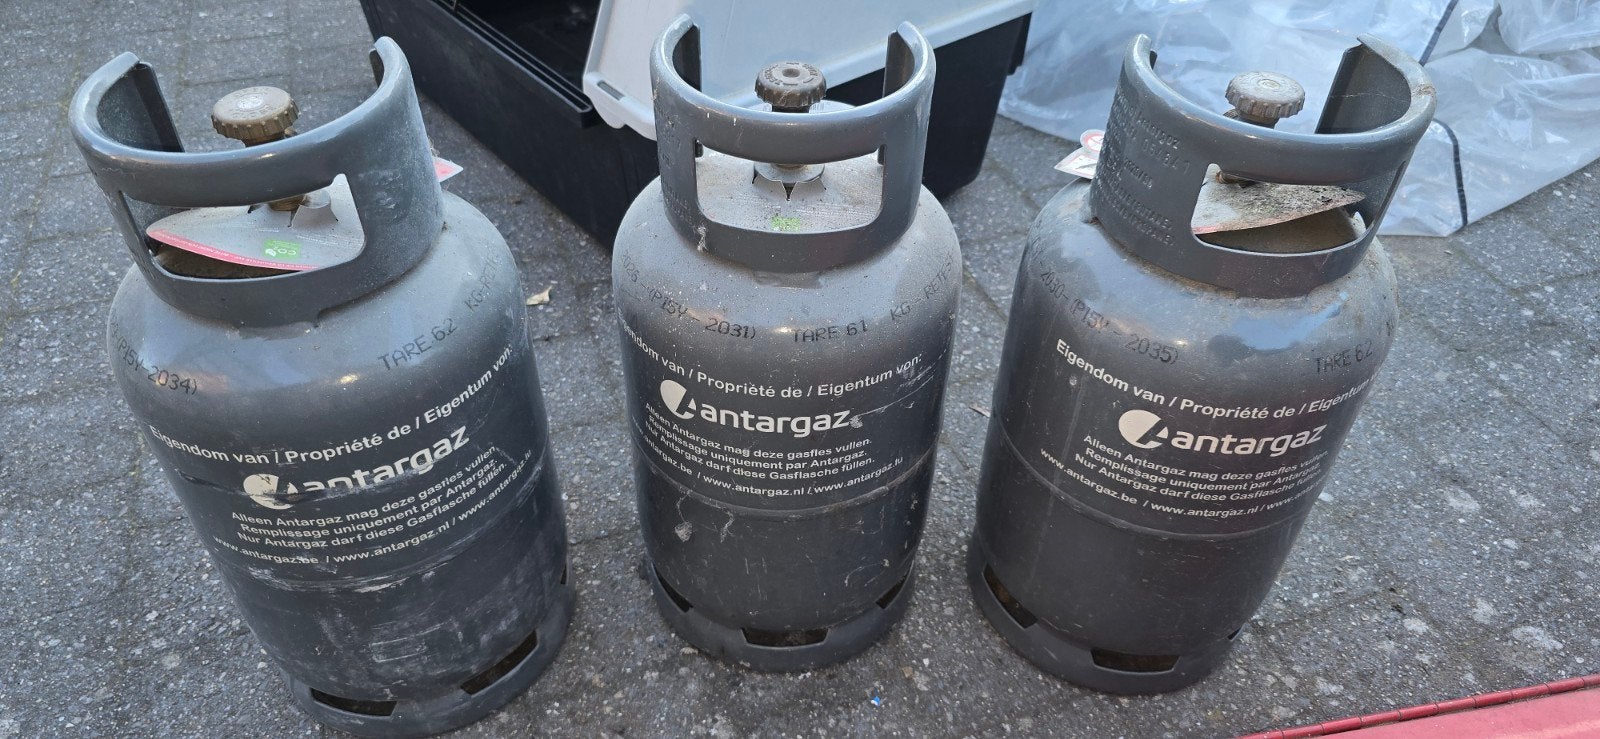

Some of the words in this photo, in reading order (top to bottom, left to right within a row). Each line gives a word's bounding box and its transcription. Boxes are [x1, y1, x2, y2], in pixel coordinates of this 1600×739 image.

[377, 335, 432, 371] TARE
[792, 325, 839, 342] TARE
[846, 319, 868, 337] 61
[661, 356, 685, 377] van
[697, 371, 776, 398] Propriété
[780, 387, 803, 398] de
[817, 370, 893, 396] Eigentum
[895, 354, 922, 374] von:
[1056, 338, 1129, 392] Eigendom
[1133, 386, 1165, 405] van
[1180, 398, 1269, 419] Propriété
[1273, 406, 1295, 418] de
[1315, 351, 1351, 374] TARE
[149, 423, 229, 462] Eigendom
[233, 453, 269, 464] van
[285, 434, 383, 463] Propriété
[387, 426, 411, 440] de
[424, 370, 492, 423] Eigentum
[492, 344, 513, 371] von:
[700, 403, 850, 438] antargaz
[303, 426, 469, 492] antargaz
[649, 415, 708, 456] Remplissage
[711, 450, 783, 469] uniquement
[785, 461, 808, 471] par
[810, 450, 867, 468] Antargaz.
[660, 435, 703, 464] Antargaz
[705, 459, 732, 473] darf
[733, 467, 766, 479] diese
[769, 468, 839, 480] Gasflasche
[841, 457, 875, 472] füllen.
[672, 423, 721, 449] Antargaz
[723, 444, 751, 457] mag
[753, 449, 784, 459] deze
[787, 448, 833, 460] gasfles
[835, 438, 872, 453] vullen.
[1083, 435, 1122, 459] Alleen
[1124, 454, 1186, 476] Antargaz
[1188, 470, 1218, 482] mag
[1221, 468, 1252, 480] deze
[1255, 463, 1298, 480] gasfles
[1171, 424, 1328, 457] antargaz
[703, 474, 804, 497] www.antargaz.nl
[814, 456, 903, 494] www.antargaz.lu
[1040, 448, 1138, 505] www.antargaz.be
[1151, 503, 1258, 518] www.antargaz.nl
[1075, 453, 1097, 470] Nur
[1098, 466, 1157, 492] Antargaz
[1160, 486, 1188, 499] darf
[1191, 491, 1226, 501] diese
[1229, 482, 1294, 501] Gasflasche
[1085, 447, 1167, 484] Remplissage
[1170, 479, 1247, 491] uniquement
[1250, 480, 1271, 491] par
[212, 536, 319, 565] www.antargaz.be
[333, 521, 450, 563] www.antargaz.nl
[458, 450, 532, 521] www.antargaz.lu
[231, 511, 273, 526] Alleen
[276, 514, 343, 527] Antargaz
[346, 508, 379, 524] mag
[382, 495, 416, 513] deze
[418, 471, 463, 500] gasfles
[237, 531, 260, 544] Nur
[264, 537, 328, 550] Antargaz
[331, 533, 363, 546] darf
[366, 524, 404, 540] diese
[407, 486, 476, 527] Gasflasche
[477, 463, 507, 489] füllen.
[240, 523, 330, 539] Remplissage
[334, 507, 419, 535] uniquement
[421, 494, 443, 511] par
[446, 459, 498, 498] Antargaz.
